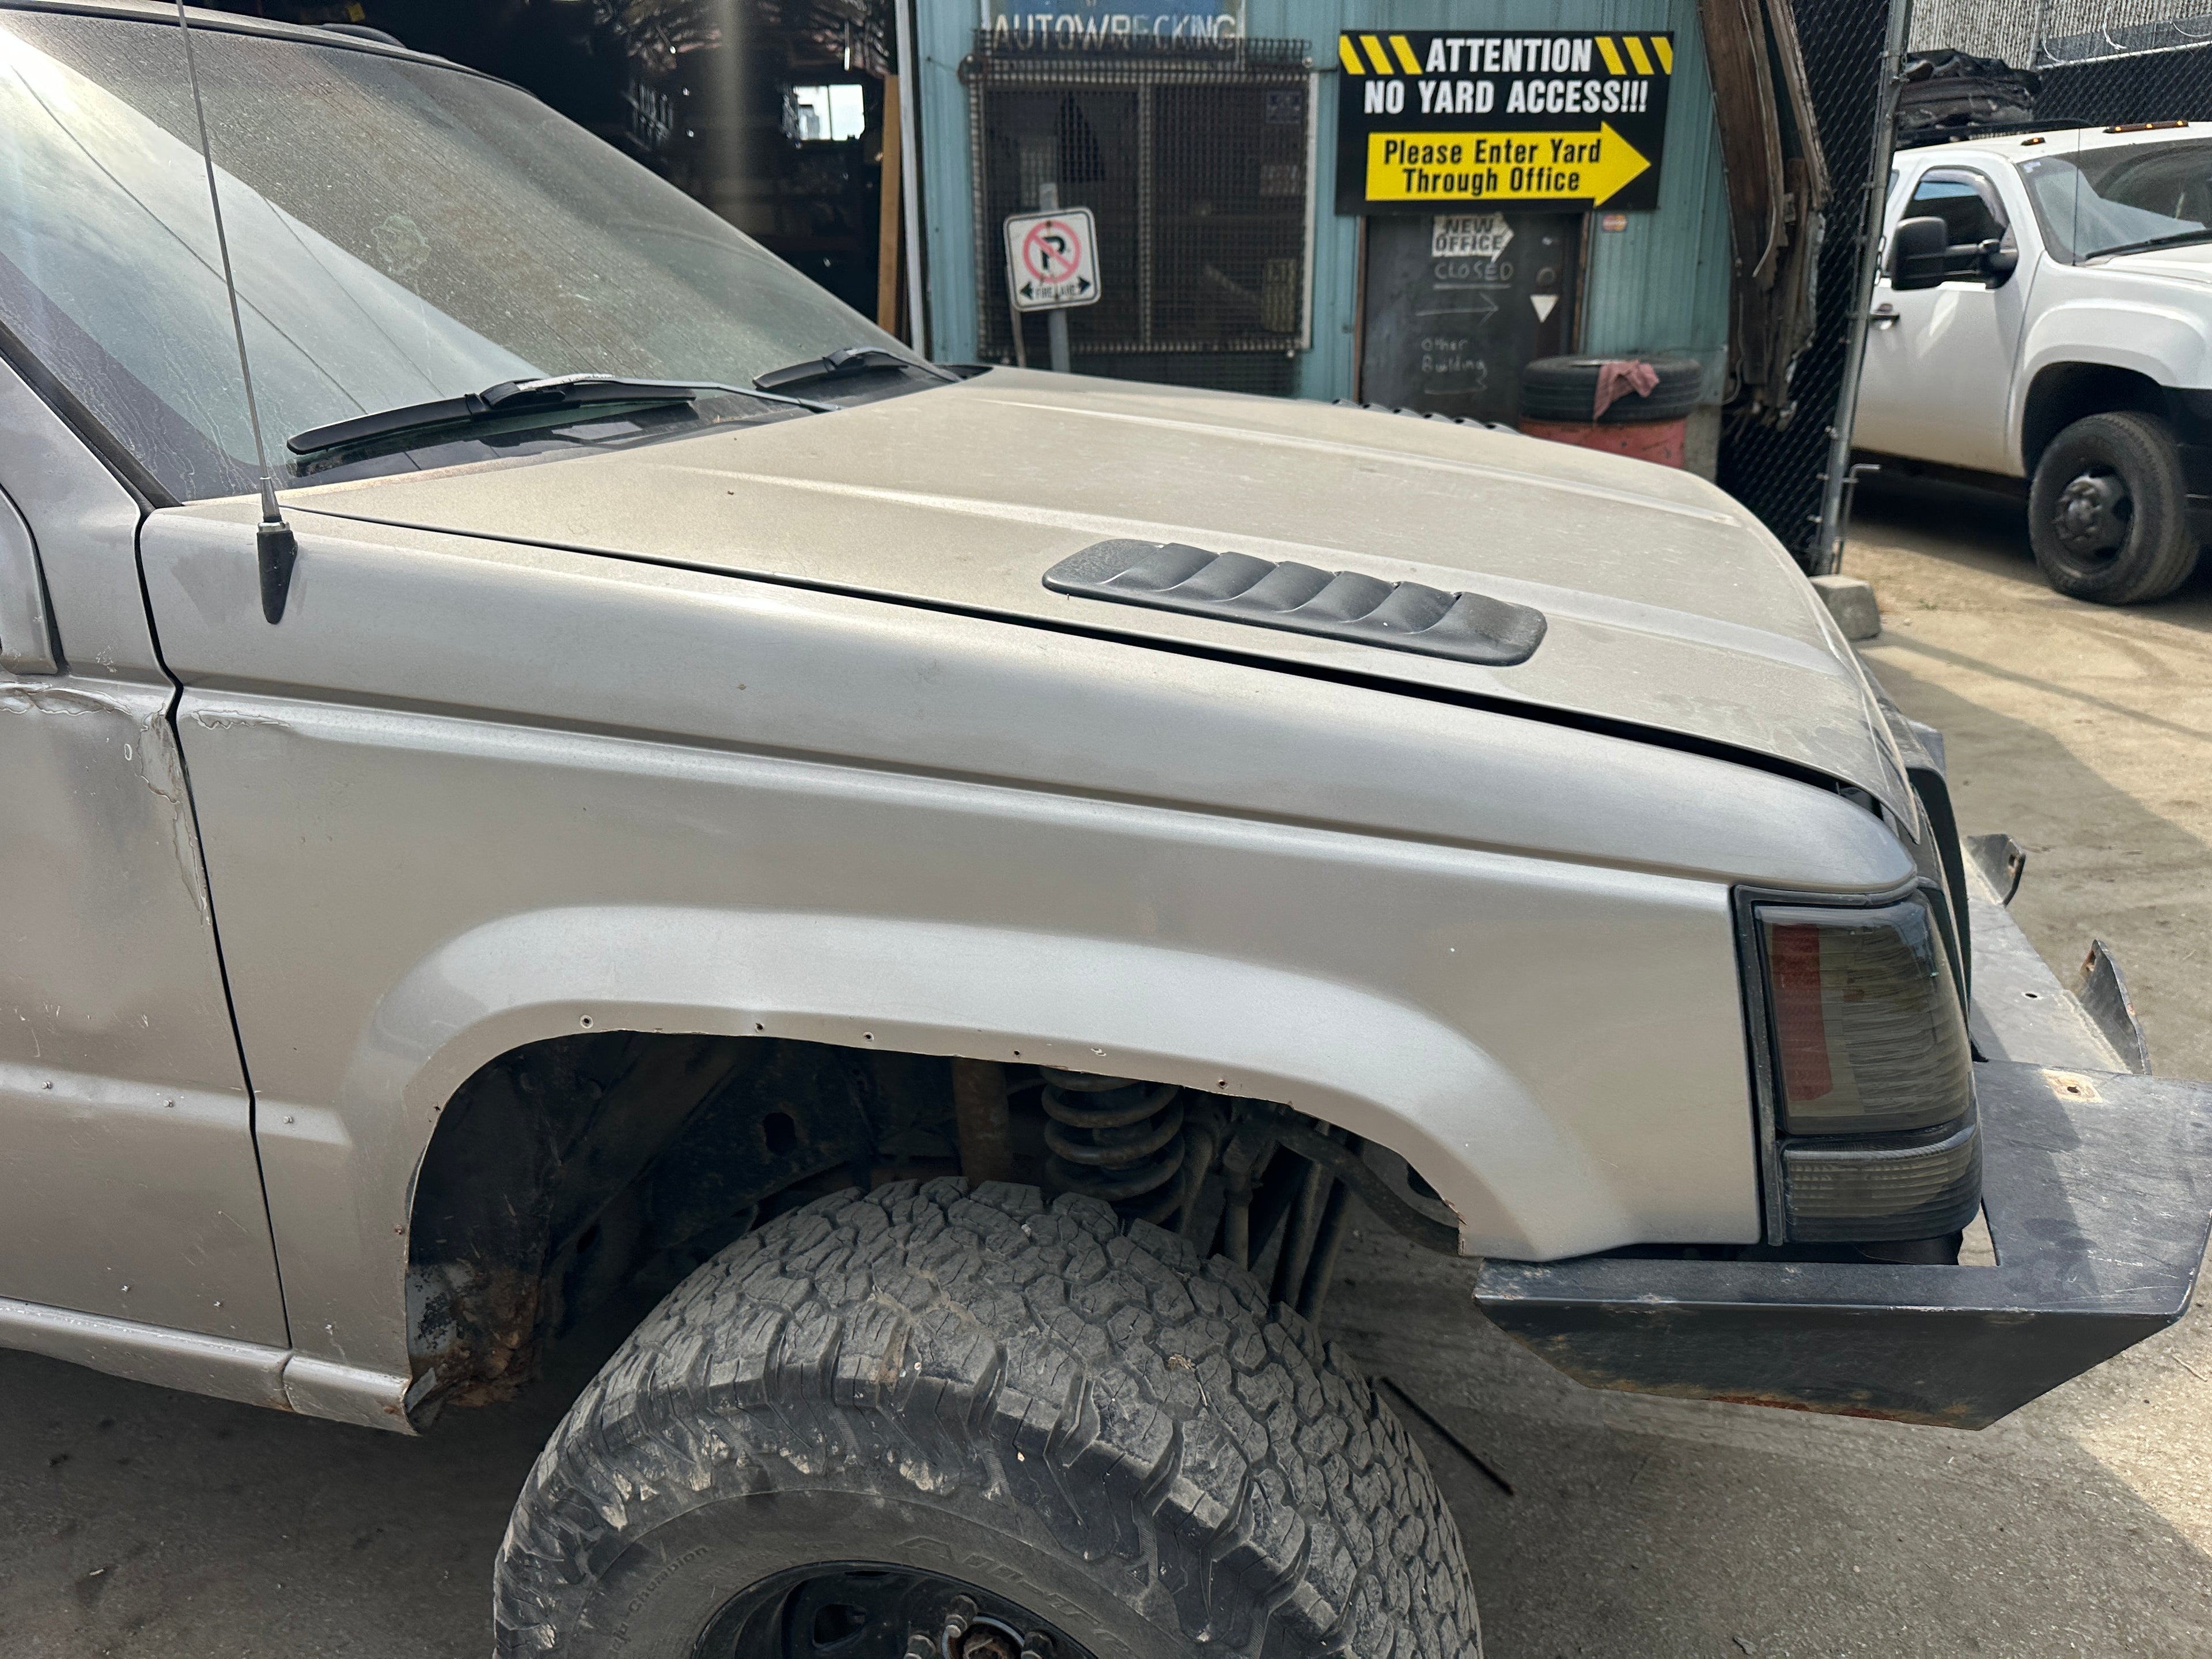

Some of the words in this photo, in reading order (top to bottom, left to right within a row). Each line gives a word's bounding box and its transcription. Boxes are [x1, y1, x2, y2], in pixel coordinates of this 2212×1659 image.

[1425, 37, 1593, 73] ATTENTION
[1363, 79, 1404, 115] NO
[1419, 79, 1494, 114] YARD
[1506, 79, 1649, 114] ACCESS!!!
[1384, 139, 1461, 165] Please
[1475, 139, 1537, 164] Enter
[1550, 138, 1601, 164] Yard
[1403, 167, 1498, 196] Through
[1510, 167, 1580, 192] Office
[1446, 218, 1494, 234] NEW
[1435, 235, 1504, 252] OFFICE
[1434, 262, 1514, 280] CLOSED
